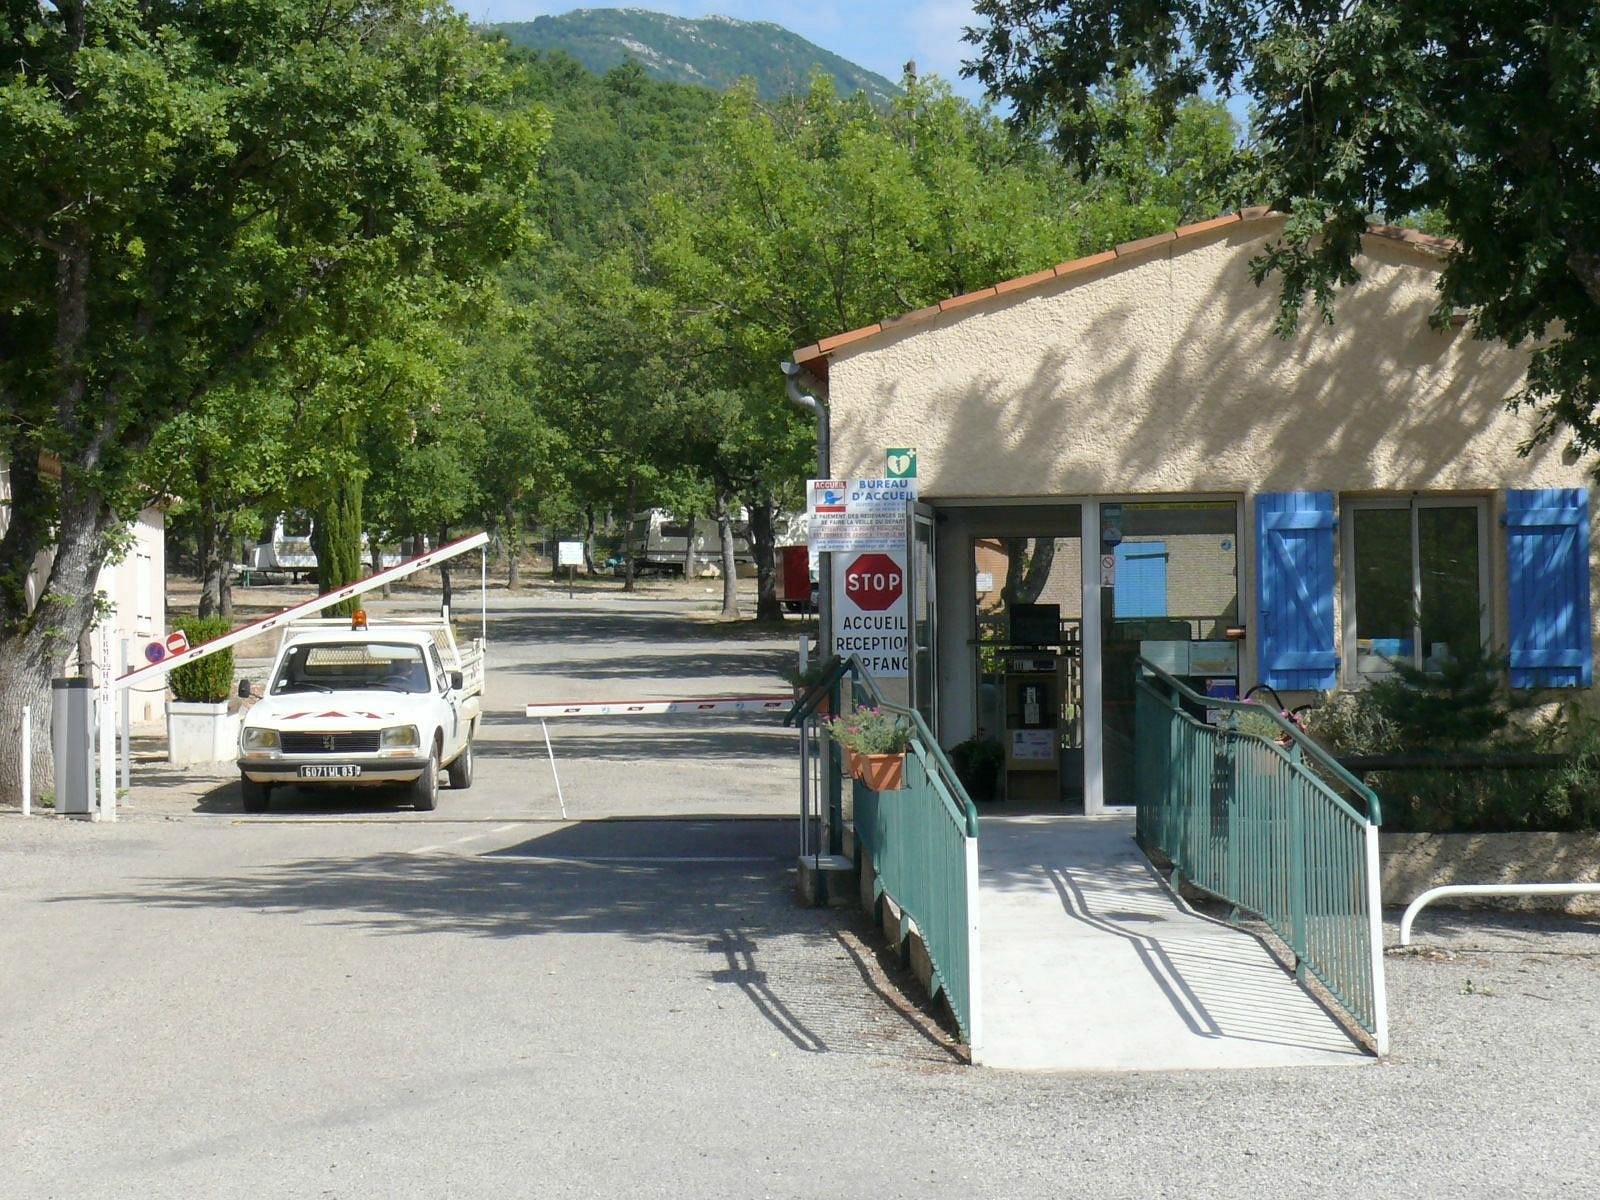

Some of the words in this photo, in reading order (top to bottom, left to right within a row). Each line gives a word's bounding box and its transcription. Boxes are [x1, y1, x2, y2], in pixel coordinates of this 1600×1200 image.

[859, 480, 908, 489] BUREAU
[852, 492, 915, 501] D'ACCUEIL
[848, 573, 900, 591] STOP
[843, 616, 907, 630] ACCUEIL
[840, 657, 908, 671] PFAN
